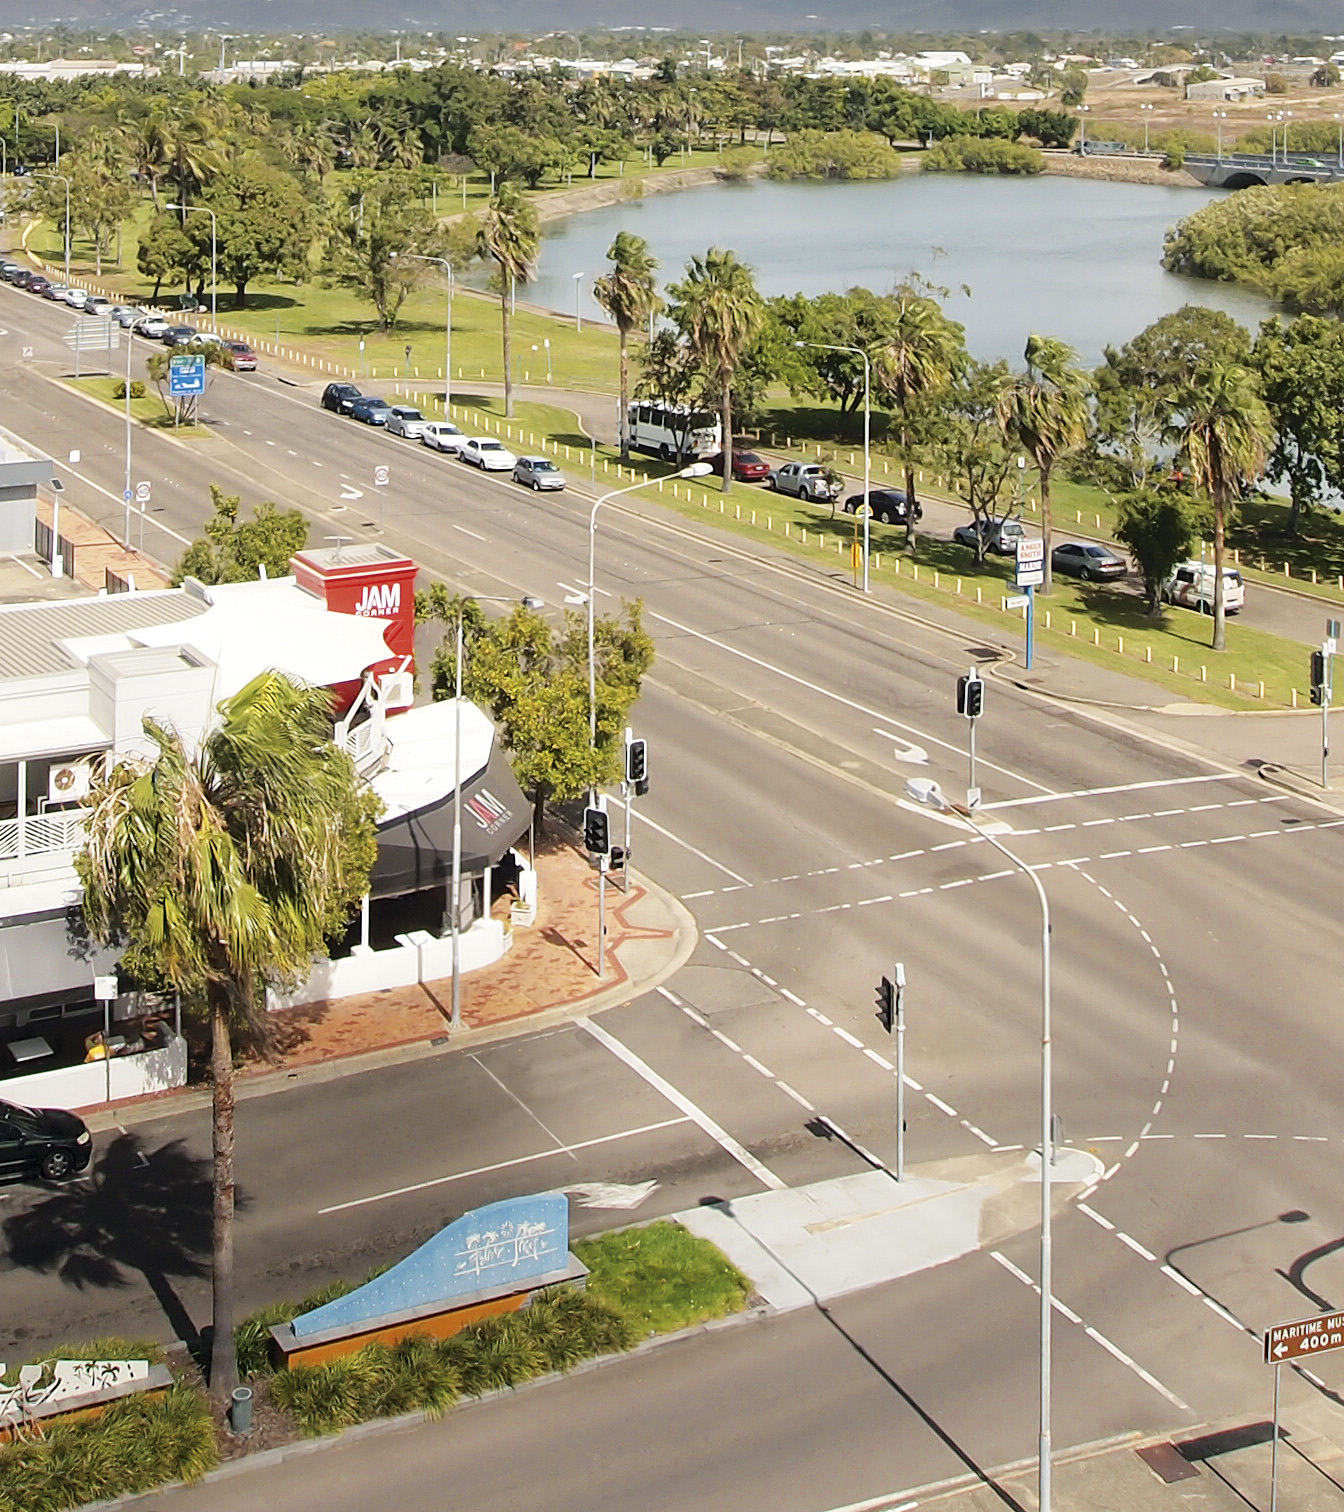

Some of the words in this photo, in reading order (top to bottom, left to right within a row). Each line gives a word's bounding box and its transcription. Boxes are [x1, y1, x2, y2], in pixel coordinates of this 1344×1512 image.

[355, 583, 401, 611] JAM
[356, 607, 399, 617] CORNER
[464, 788, 507, 829] JAM
[486, 810, 514, 835] CORNER
[1273, 1320, 1323, 1342] MARITIME
